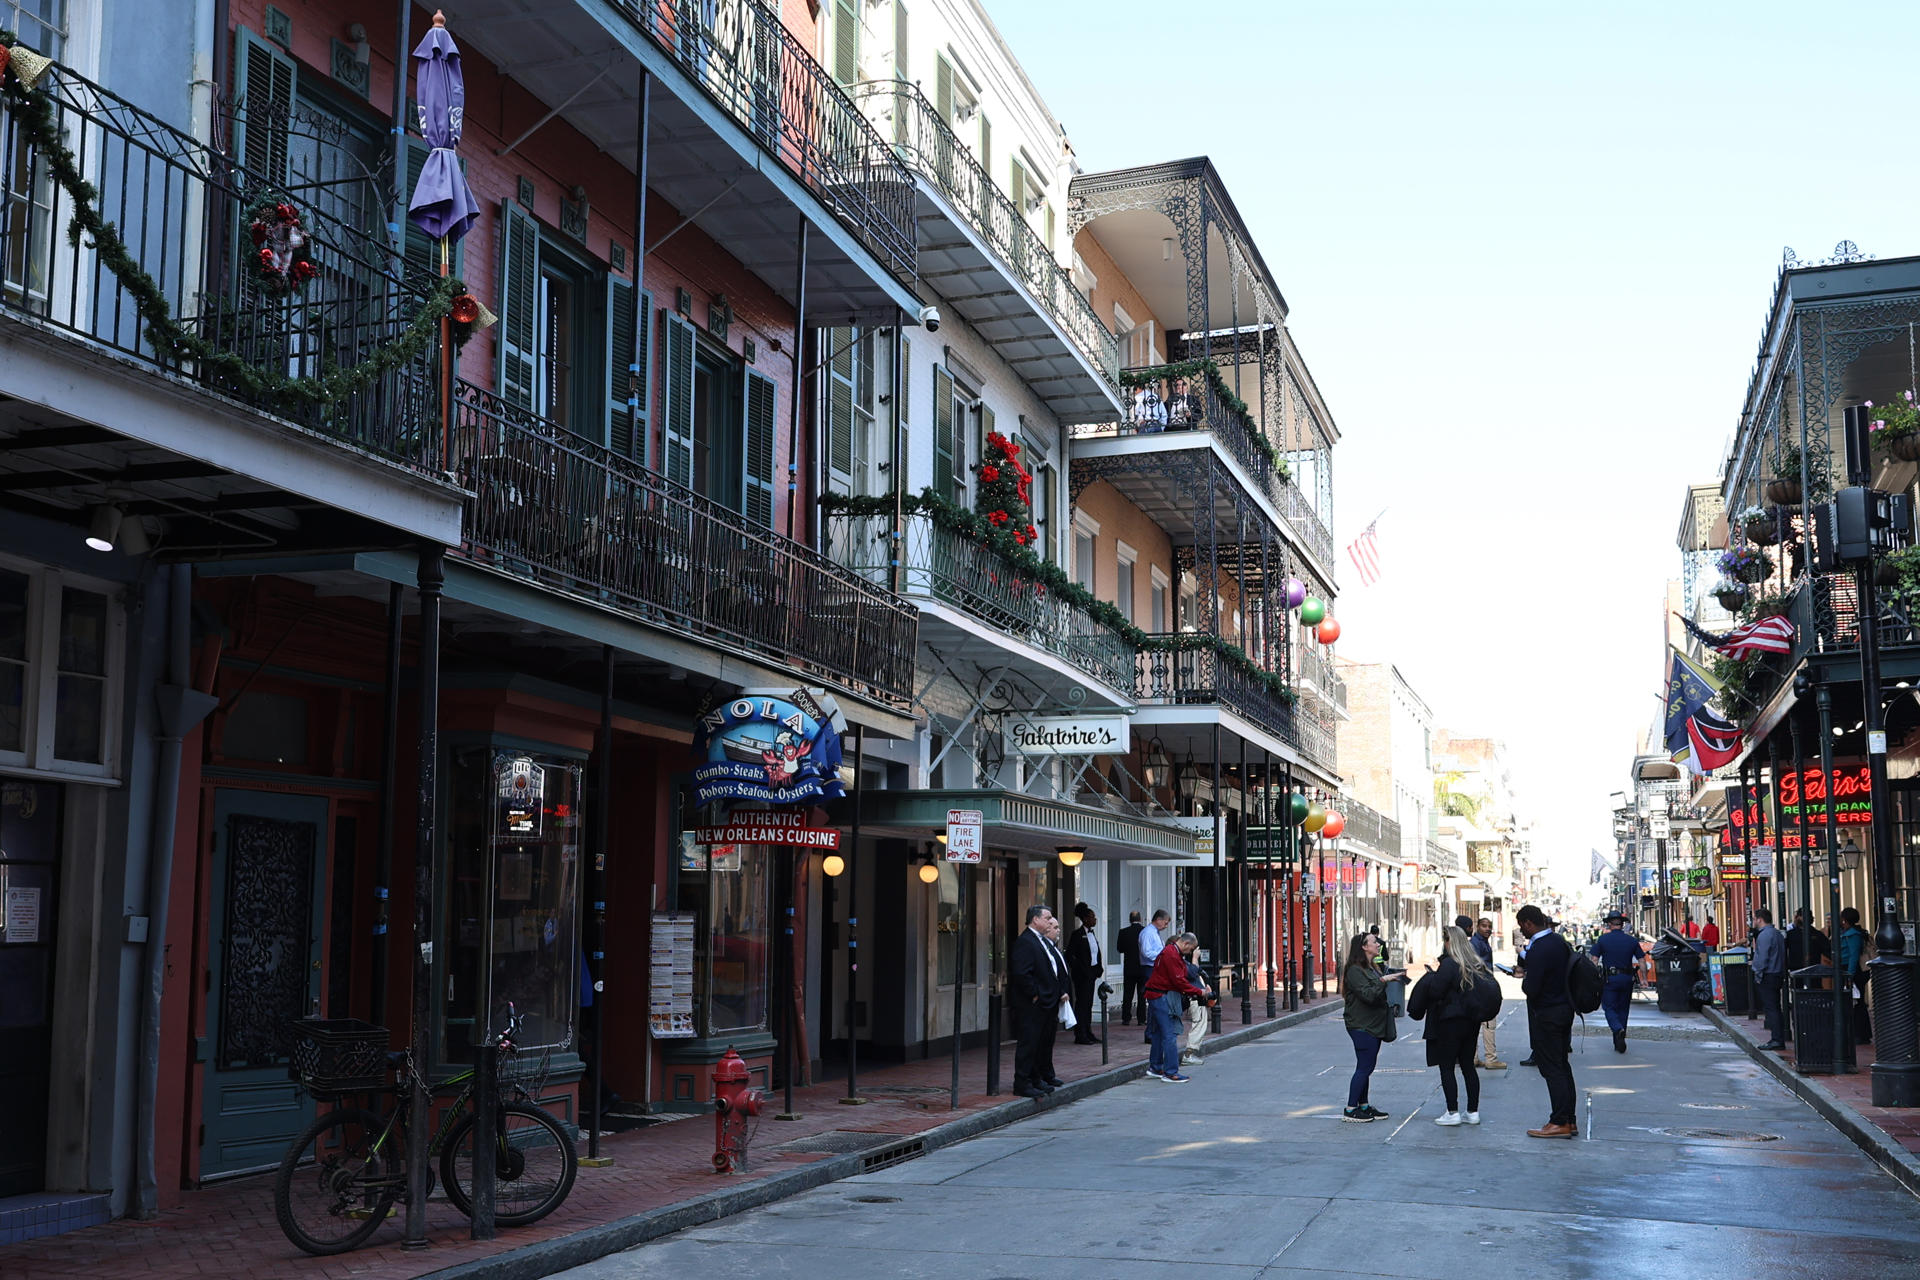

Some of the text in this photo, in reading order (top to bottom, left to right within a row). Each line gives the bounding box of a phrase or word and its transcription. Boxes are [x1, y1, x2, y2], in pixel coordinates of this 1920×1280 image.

[793, 690, 822, 721] COOKERY
[703, 699, 804, 736] NOLA
[1013, 723, 1117, 747] Galatoire's
[514, 763, 529, 774] Lite
[695, 763, 764, 781] Gumbo Steaks
[699, 781, 814, 802] Poboys Seafood Oysters
[732, 811, 801, 827] AUTHENTIC
[949, 812, 960, 823] NO
[697, 828, 836, 847] NEW ORLEANS CUISINE
[955, 828, 973, 837] FIRE
[953, 839, 975, 848] LANE
